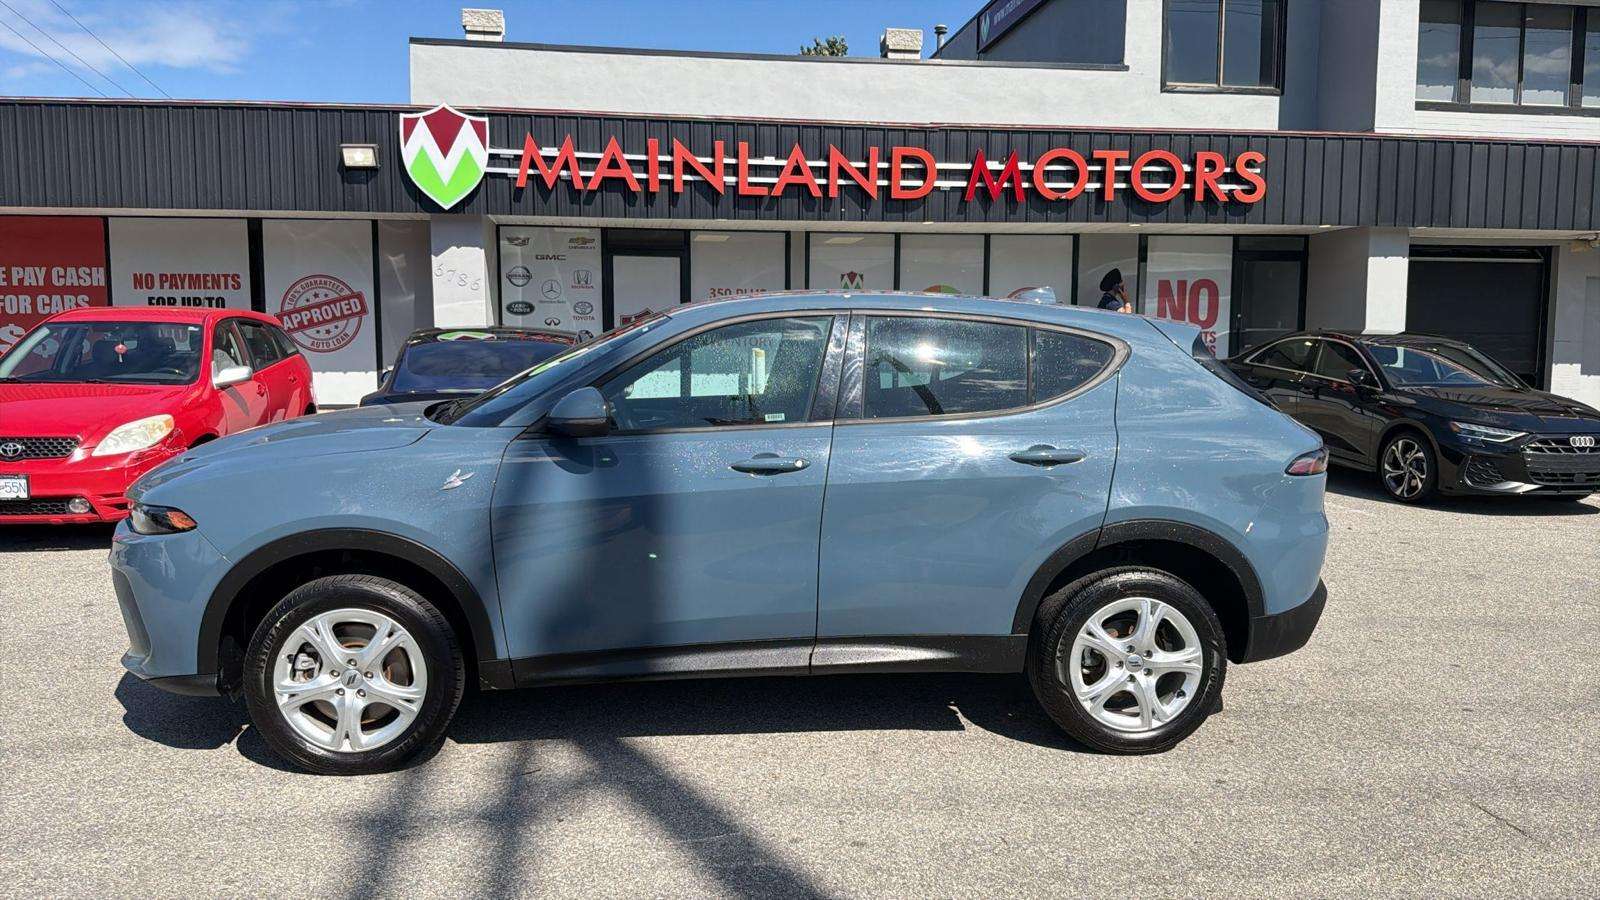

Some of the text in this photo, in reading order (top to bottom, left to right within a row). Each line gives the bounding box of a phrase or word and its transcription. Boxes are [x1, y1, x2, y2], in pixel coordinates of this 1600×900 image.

[515, 131, 1267, 203] MAINLAND MOTORS
[11, 266, 47, 287] PAY
[51, 266, 105, 287] CASH
[132, 272, 242, 291] NO PAYMENTS
[434, 263, 481, 290] 6786
[37, 294, 90, 315] CARS
[287, 279, 345, 306] 100% GUARANTEED
[1156, 278, 1219, 329] NO
[282, 297, 362, 331] APPROVED
[310, 331, 351, 349] AUTO LOAN
